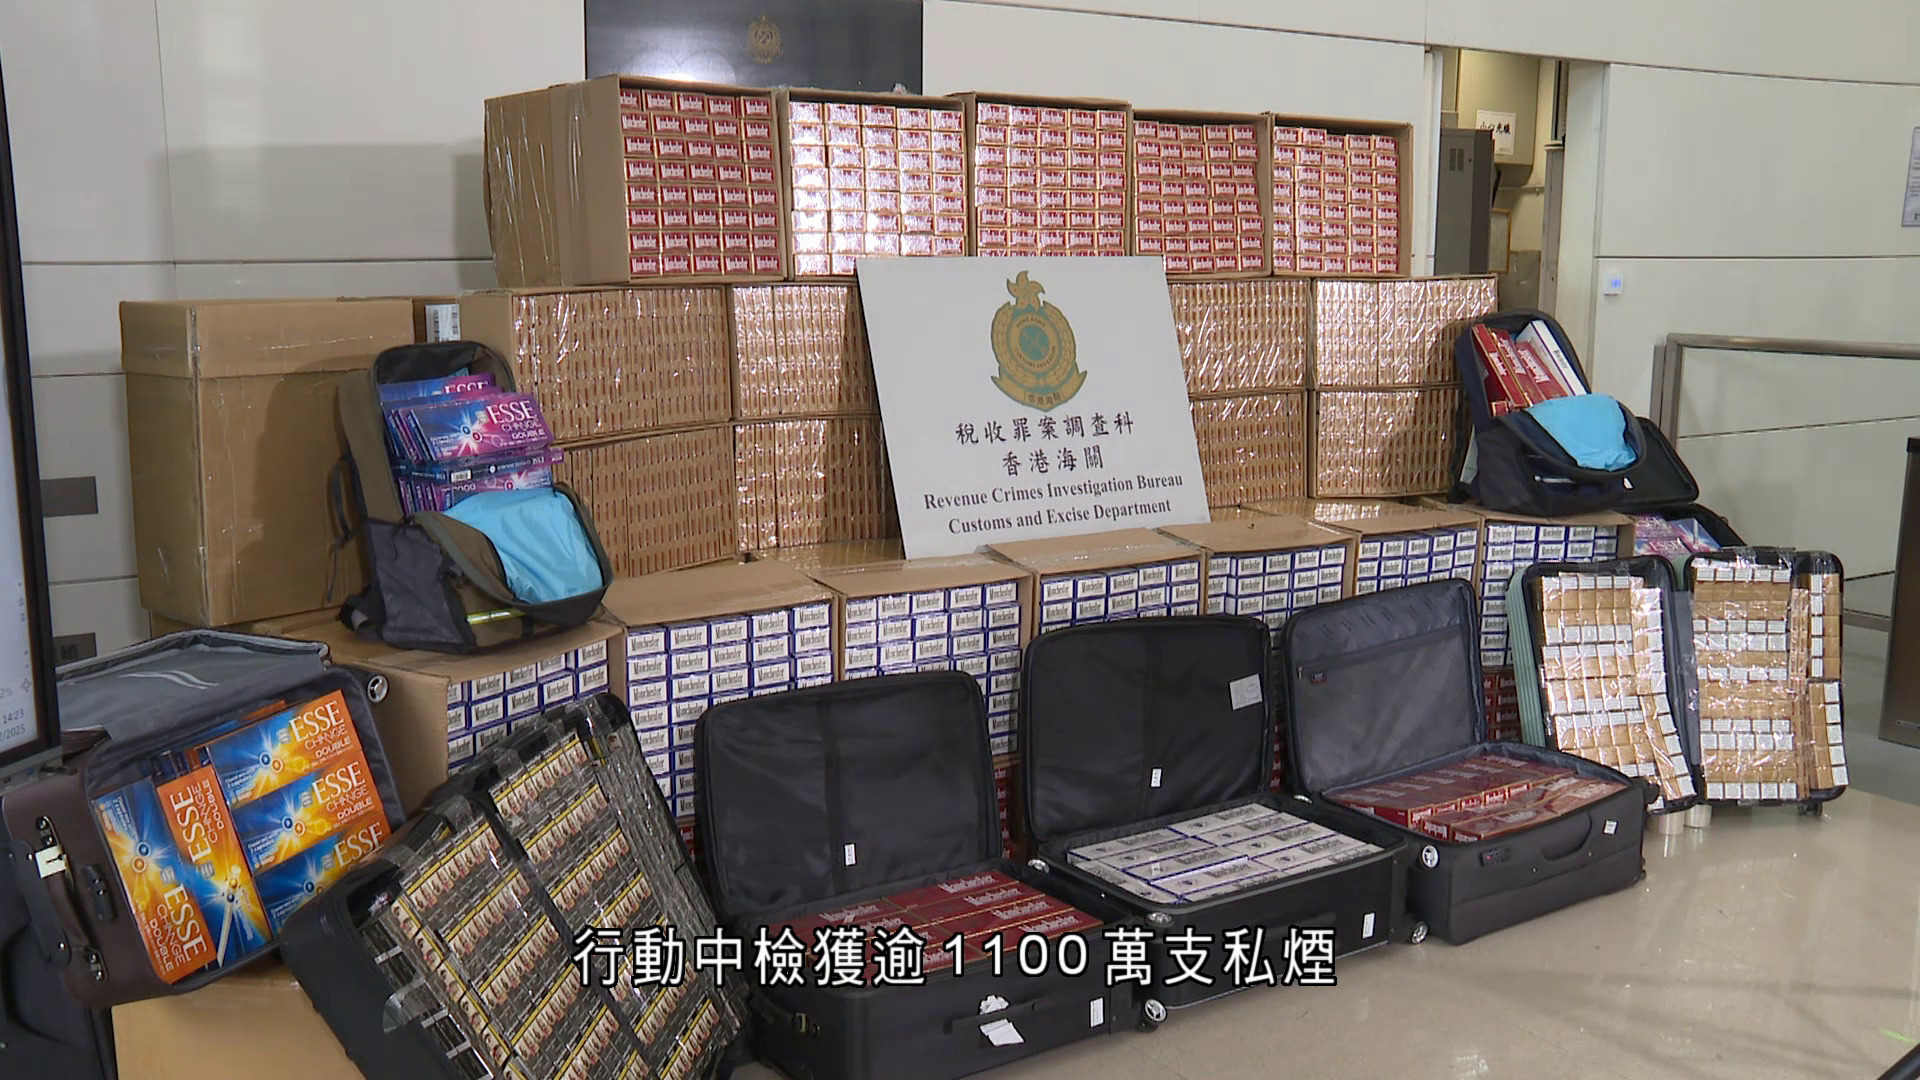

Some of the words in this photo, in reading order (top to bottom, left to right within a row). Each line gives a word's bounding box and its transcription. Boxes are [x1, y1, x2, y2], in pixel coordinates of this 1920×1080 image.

[486, 400, 537, 424] ESSE
[1002, 445, 1104, 476] 香港海關
[924, 491, 988, 509] Revenue
[992, 486, 1043, 503] Crimes
[1047, 479, 1133, 498] Investigation
[1137, 473, 1183, 488] Bureau
[949, 518, 1012, 535] Customs
[1016, 512, 1042, 527] and
[1047, 508, 1090, 524] Excise
[1094, 500, 1172, 521] Department
[289, 701, 344, 742] ESSE
[305, 725, 348, 751] CHANGE
[315, 736, 351, 758] DOUBLE
[312, 761, 366, 804] ESSE
[326, 785, 370, 812] CHANGE
[191, 783, 218, 844] CHANGE
[202, 779, 224, 830] DOUBLE
[337, 798, 373, 820] DOUBLE
[170, 787, 211, 862] ESSE
[157, 903, 186, 967] CHANGE
[164, 884, 207, 961] ESSE
[150, 919, 174, 972] DOUBLE
